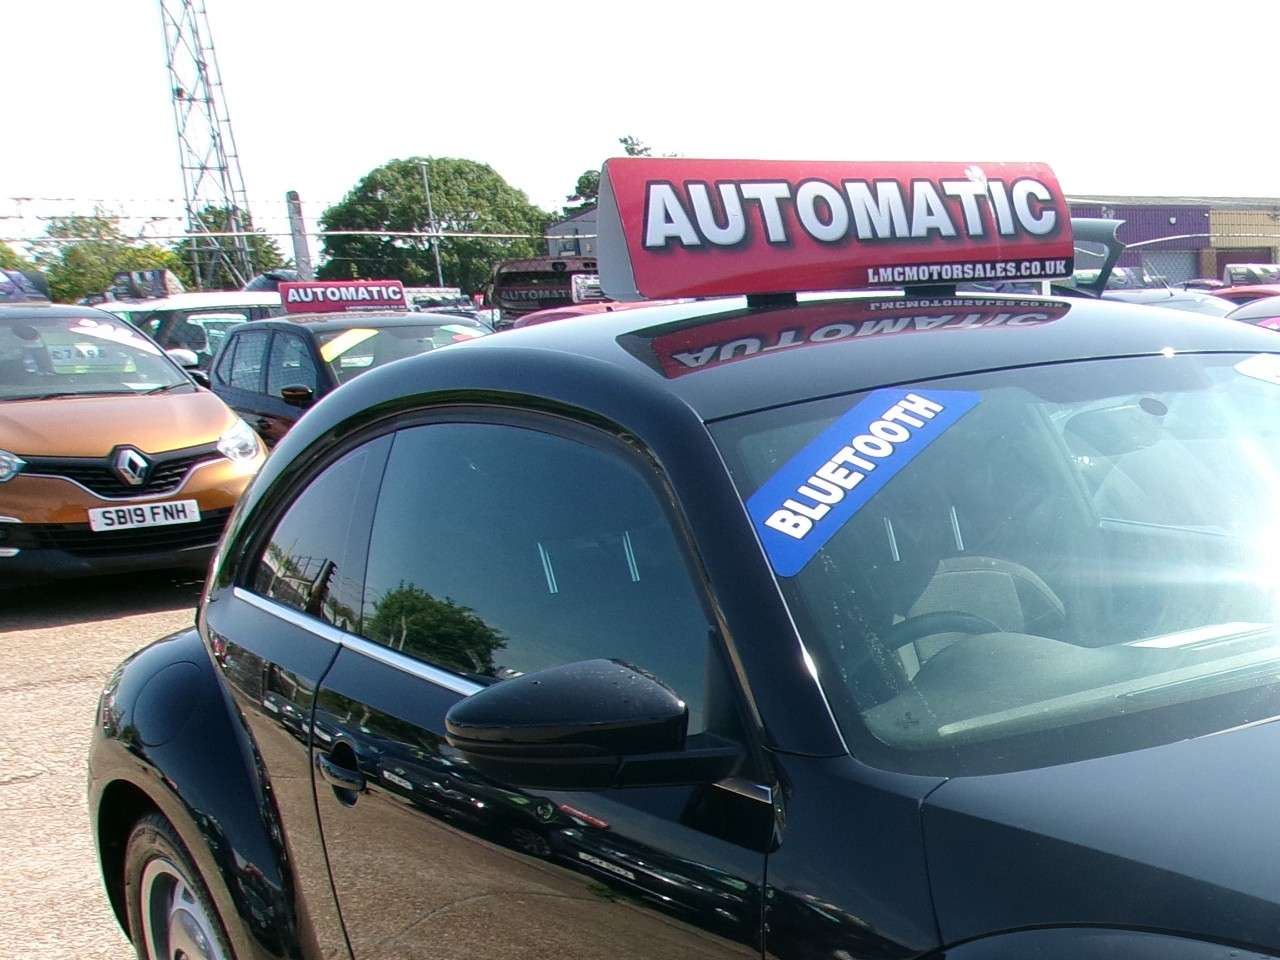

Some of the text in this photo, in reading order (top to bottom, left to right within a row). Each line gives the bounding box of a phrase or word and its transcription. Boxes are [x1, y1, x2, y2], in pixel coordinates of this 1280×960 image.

[644, 178, 1056, 248] AUTOMATIC
[867, 259, 1067, 284] LMCMOTORSALES.CO.UK
[286, 285, 402, 303] AUTOMATIC
[764, 393, 945, 540] BLUETOOTH
[101, 502, 188, 527] SB19 FNH
